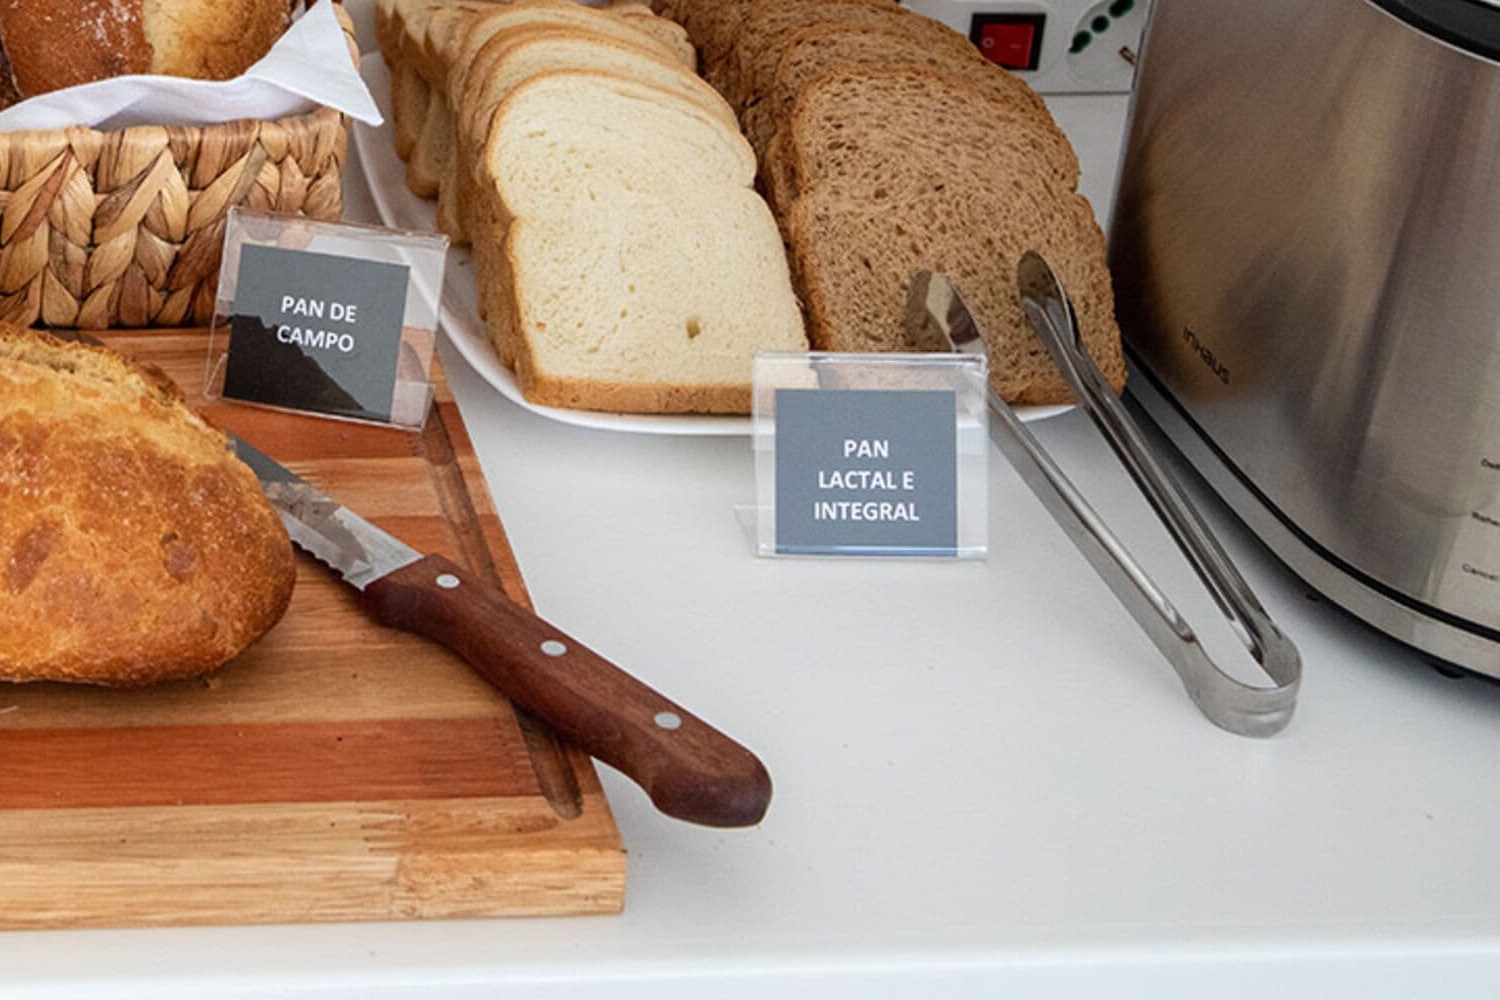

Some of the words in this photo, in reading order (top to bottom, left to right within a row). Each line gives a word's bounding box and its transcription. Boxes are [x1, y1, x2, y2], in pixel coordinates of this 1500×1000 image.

[281, 295, 324, 318] PAN
[330, 303, 357, 323] DE
[277, 324, 355, 352] CAMPO
[844, 439, 889, 458] PAN
[818, 470, 897, 489] LACTAL
[903, 471, 914, 489] E
[814, 502, 920, 521] INTEGRAL
